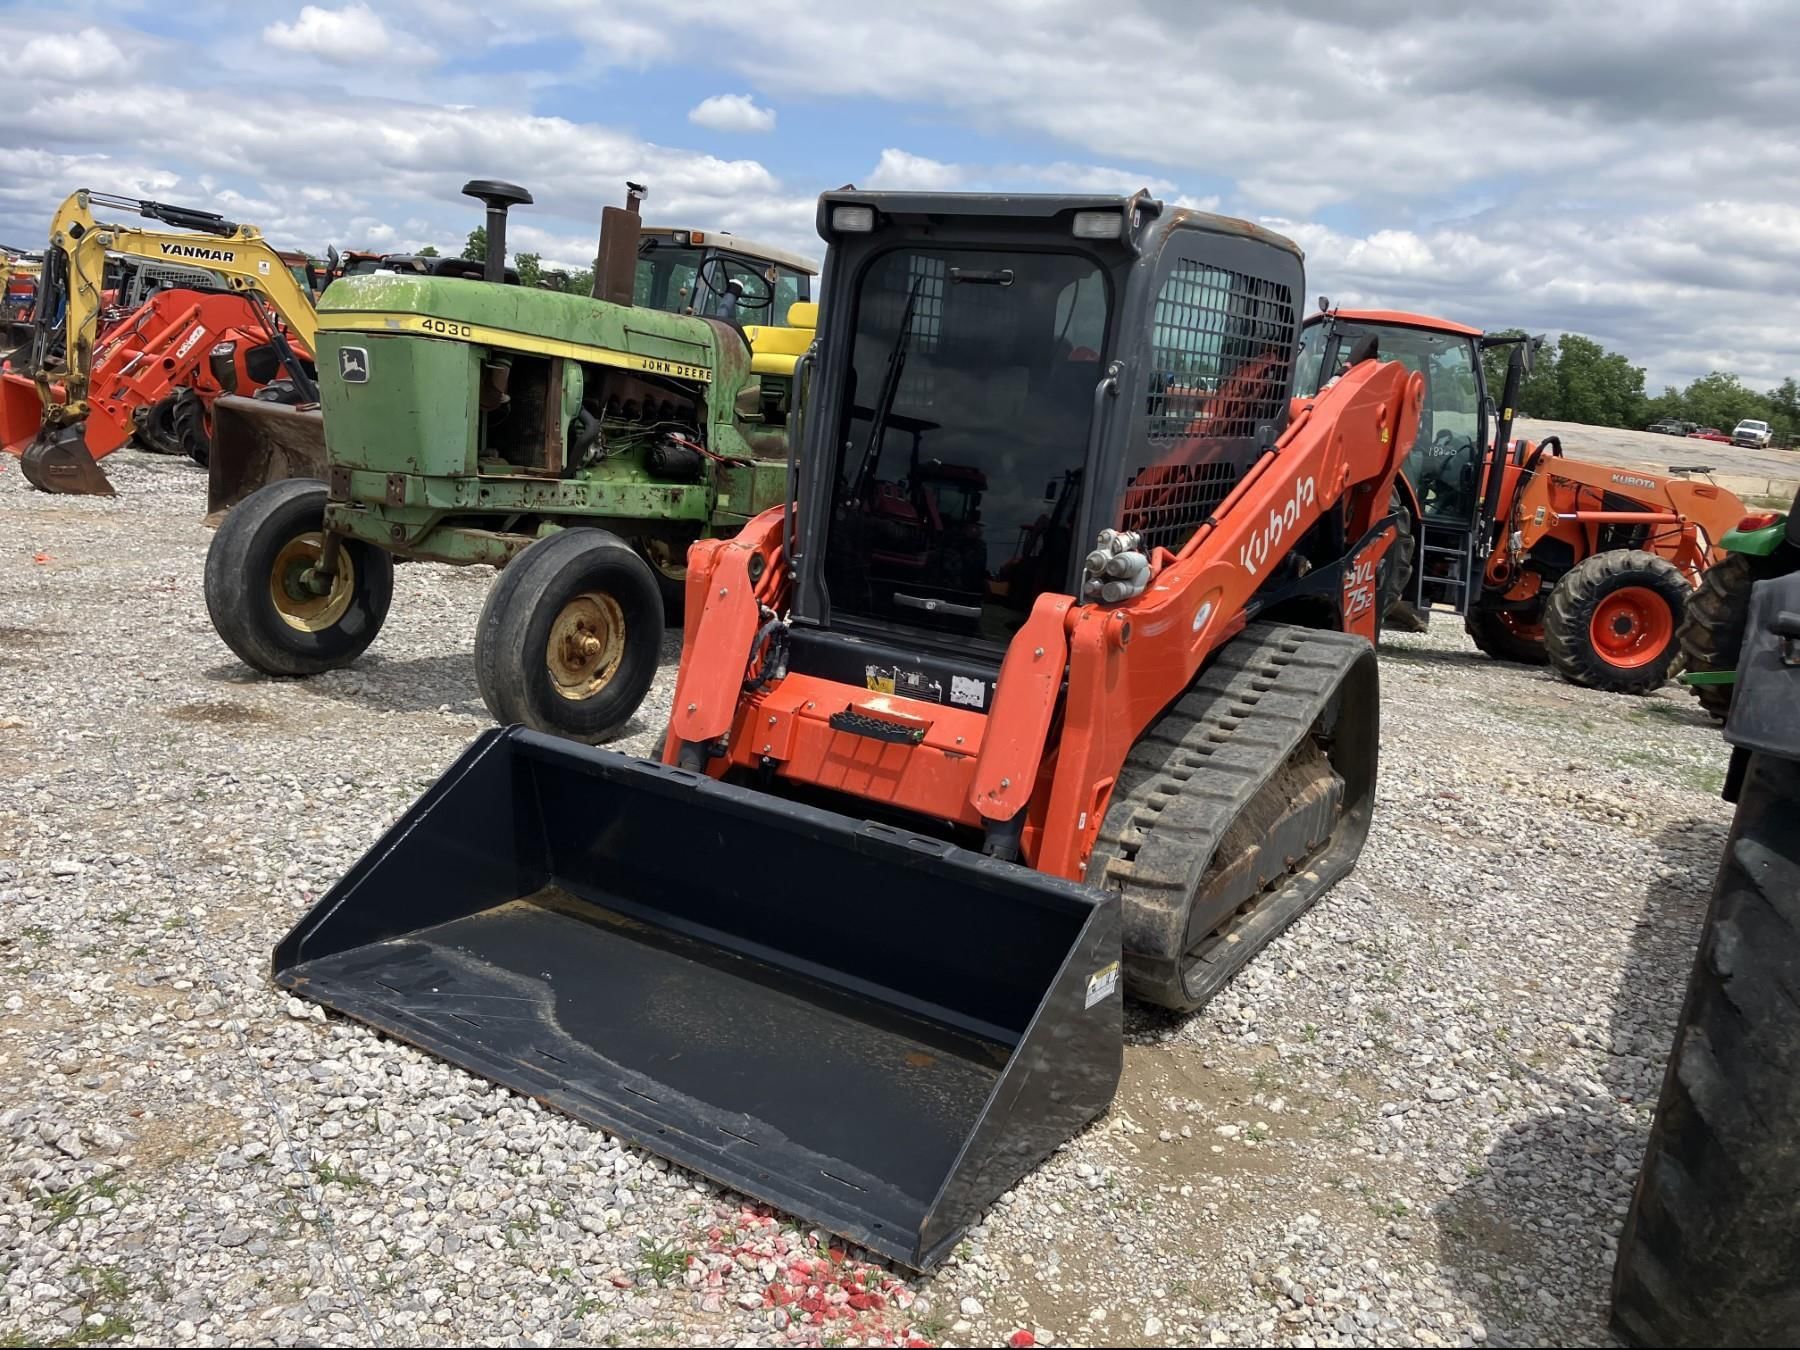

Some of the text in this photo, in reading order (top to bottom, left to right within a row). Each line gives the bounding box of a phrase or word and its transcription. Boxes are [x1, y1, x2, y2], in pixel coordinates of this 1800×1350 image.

[160, 243, 235, 262] YANMAR
[422, 319, 471, 337] 4030
[642, 360, 712, 379] JOHN DEERE
[1612, 473, 1655, 488] KUBOTA
[1240, 476, 1314, 575] Kubota
[1343, 561, 1375, 590] SVL
